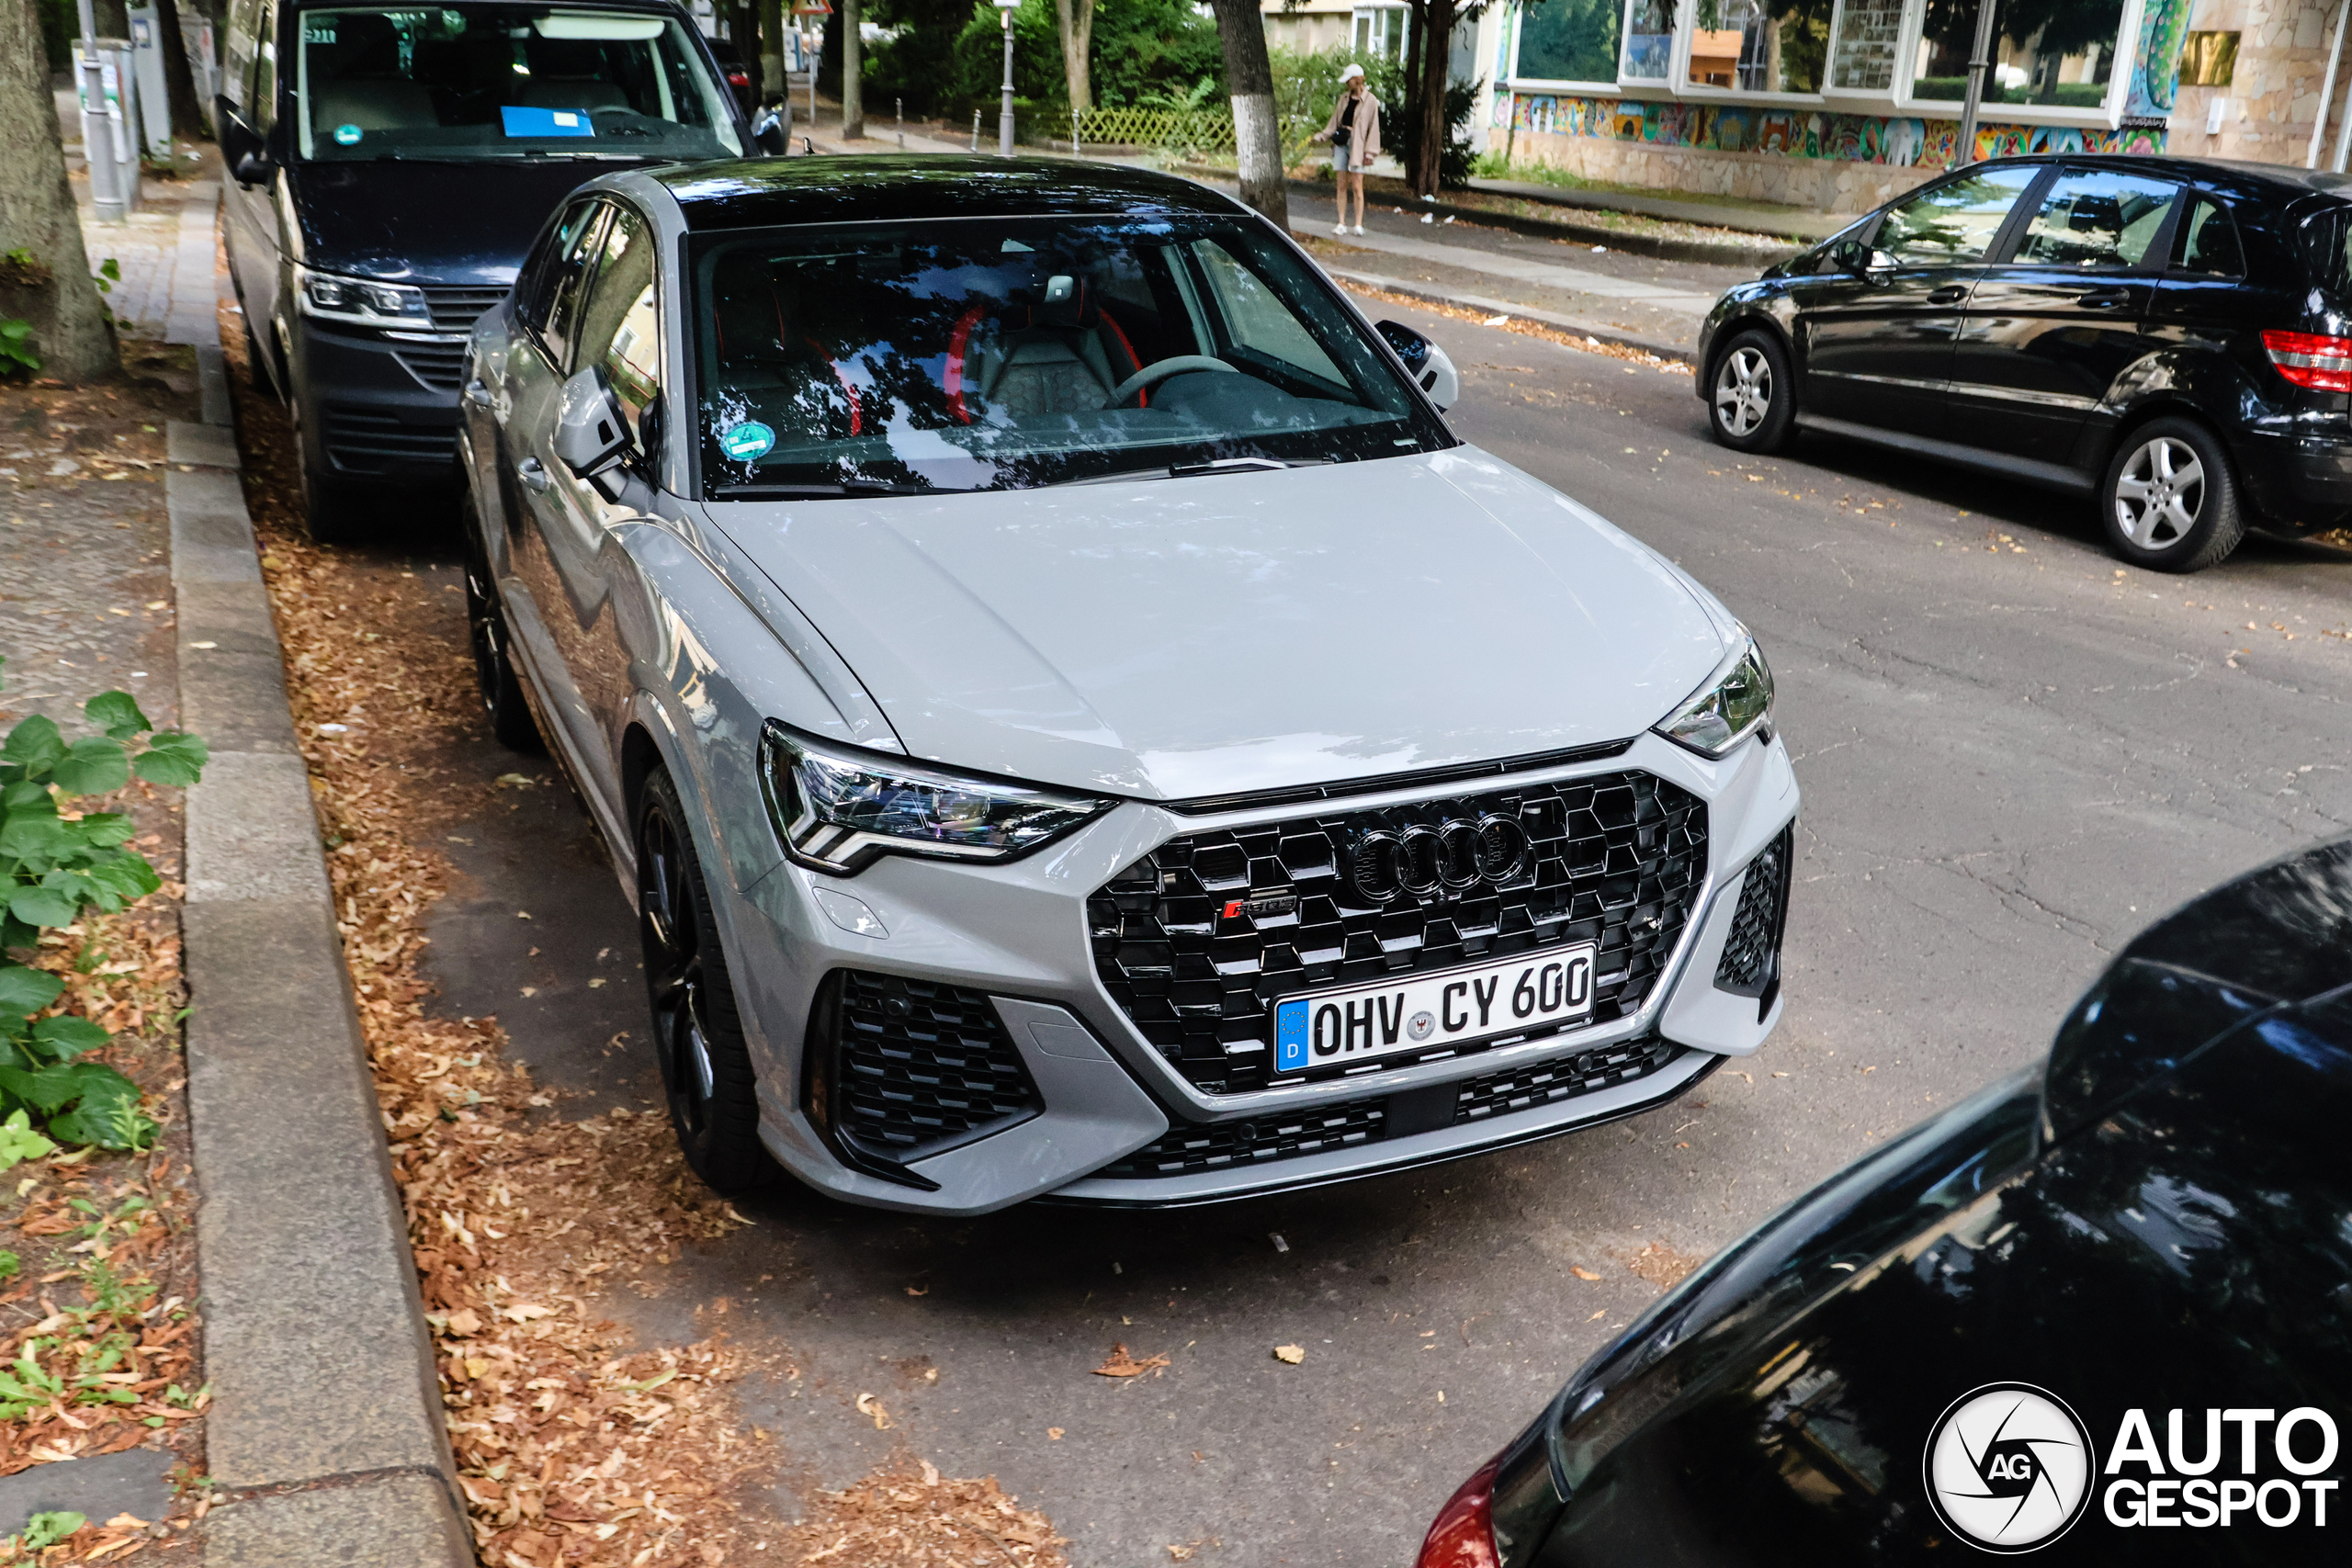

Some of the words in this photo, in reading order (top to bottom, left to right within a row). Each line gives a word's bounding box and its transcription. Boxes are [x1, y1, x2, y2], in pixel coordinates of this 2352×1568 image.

[741, 427, 753, 441] 4
[1314, 992, 1405, 1056] OHV
[1442, 975, 1498, 1032] CY
[1512, 957, 1589, 1019] 600
[1287, 1043, 1299, 1059] D
